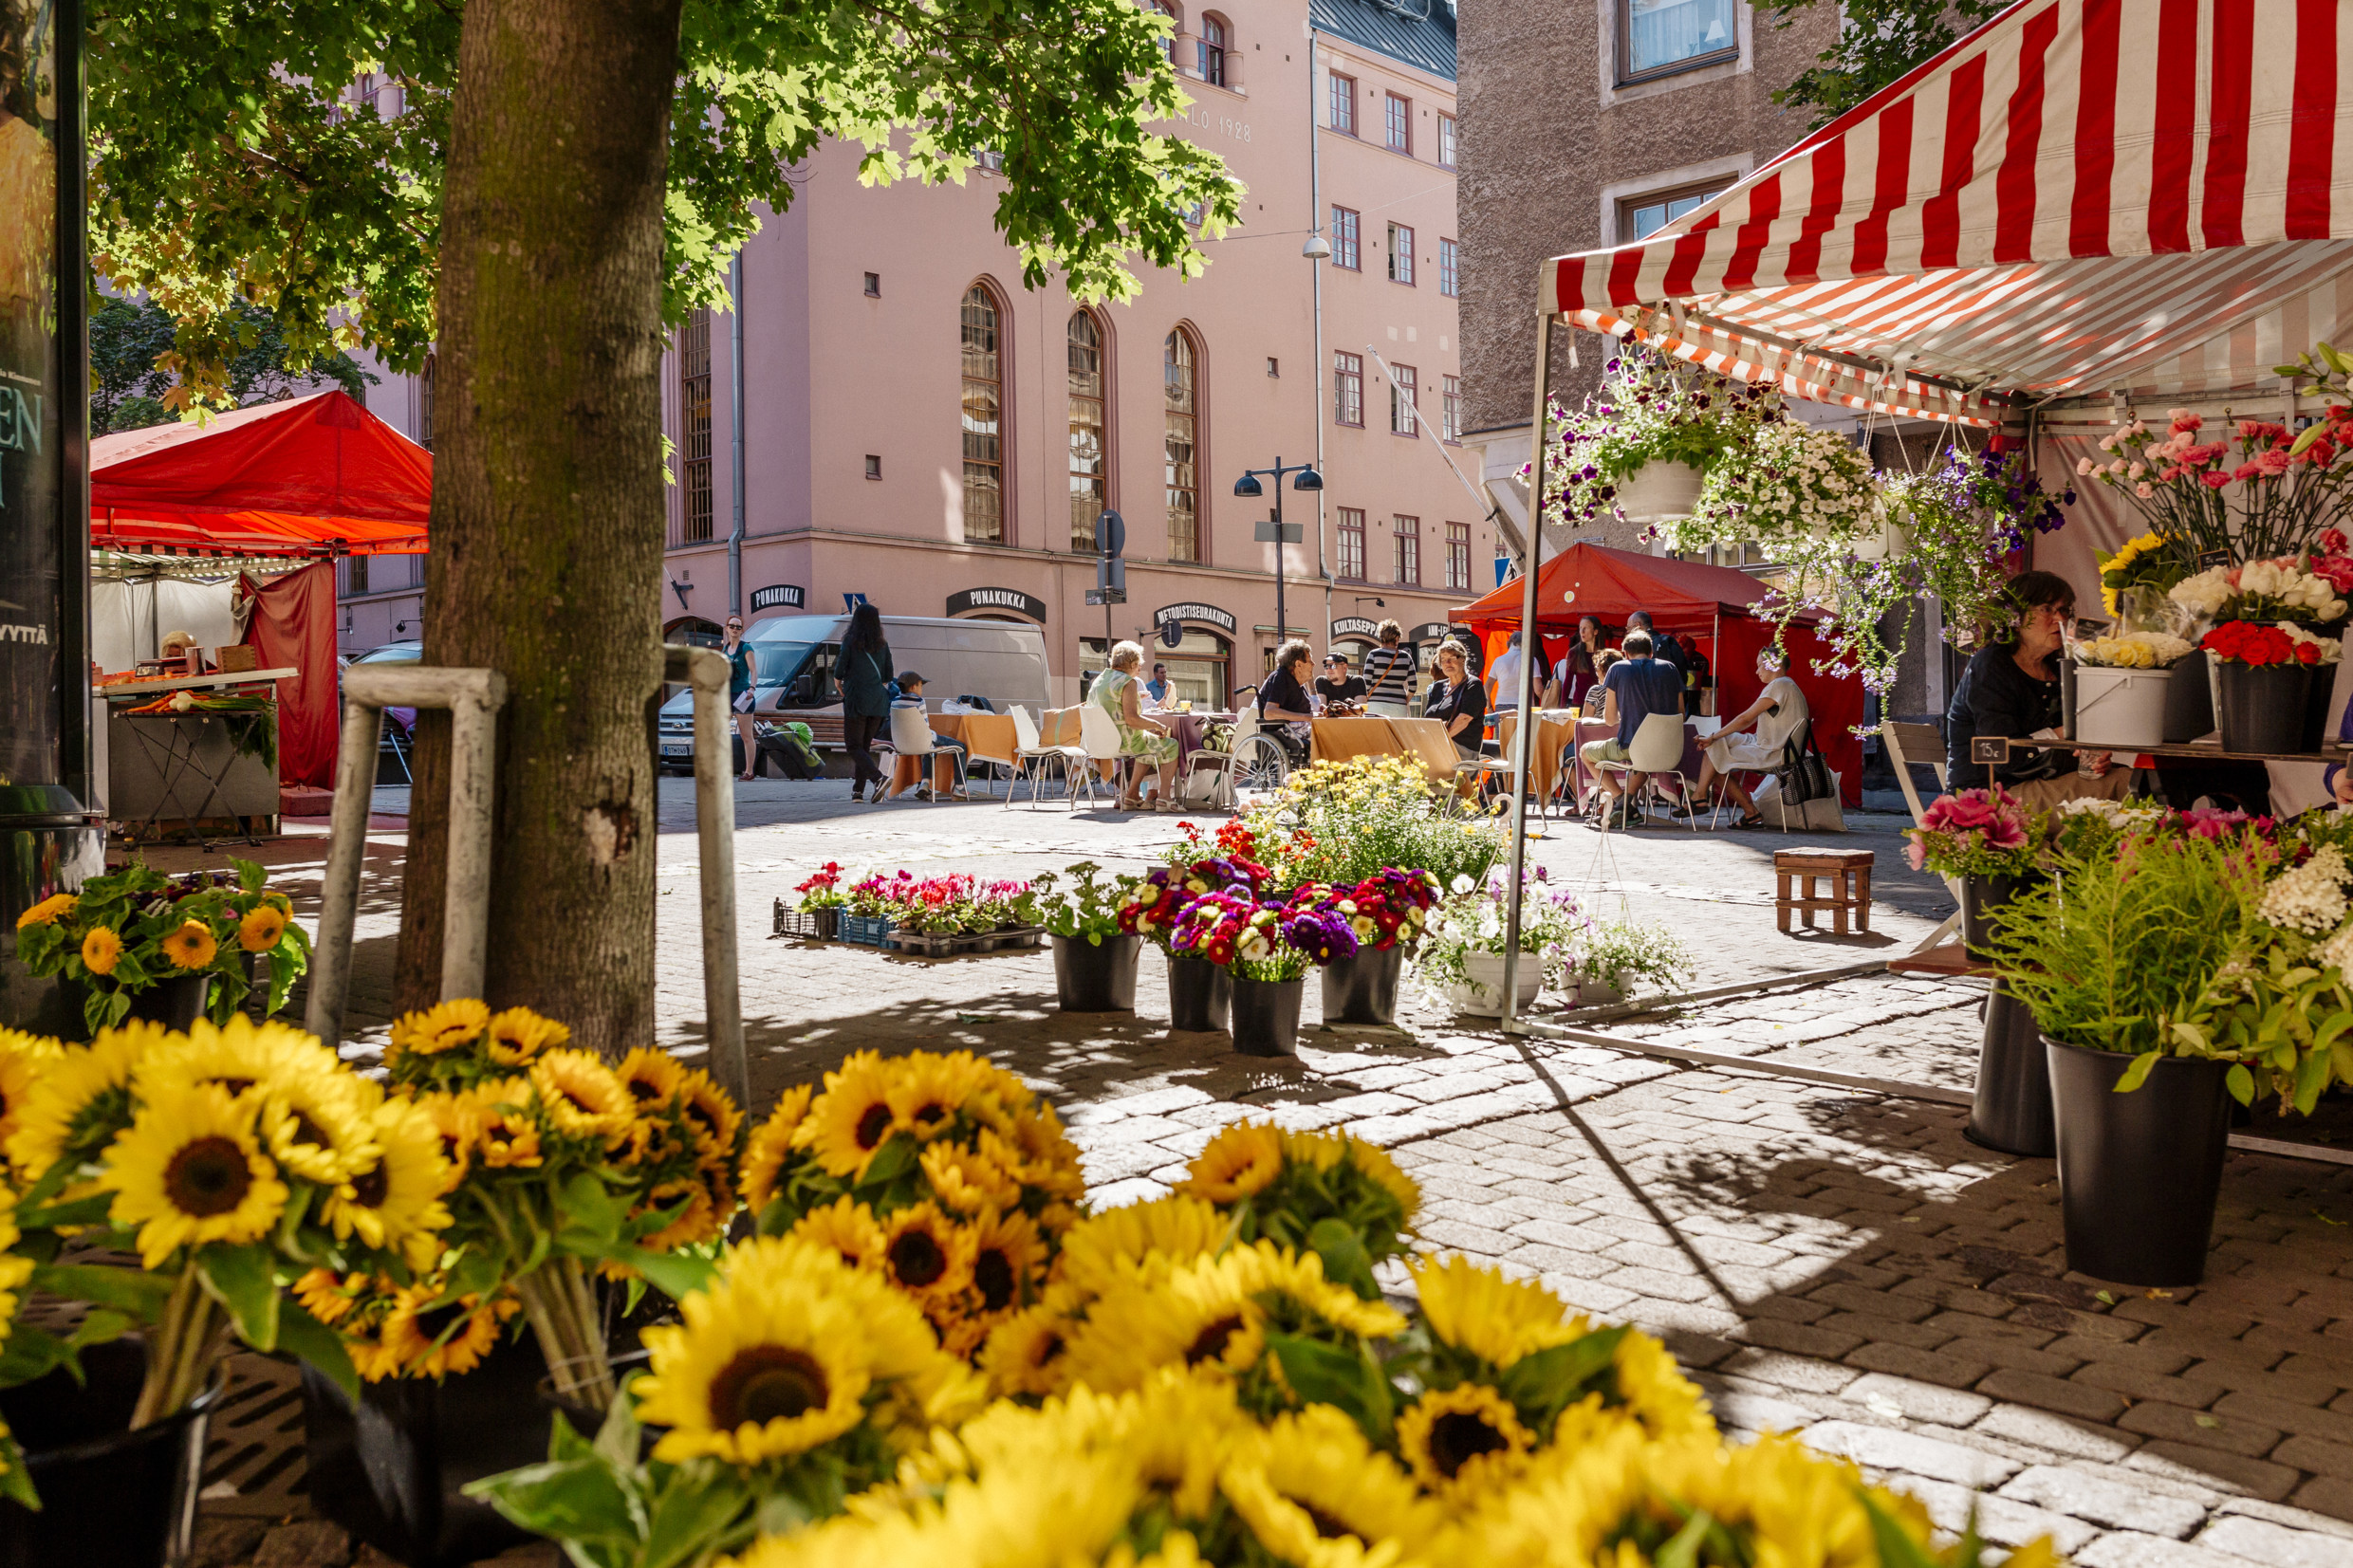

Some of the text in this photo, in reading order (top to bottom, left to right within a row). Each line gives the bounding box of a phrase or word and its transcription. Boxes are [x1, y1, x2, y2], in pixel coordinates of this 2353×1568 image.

[1219, 115, 1251, 143] 1928
[755, 587, 799, 608] PUNAKUKKA
[970, 590, 1026, 610] PUNAKUKKA
[1158, 604, 1233, 629] METODISTISEURAKUNTA
